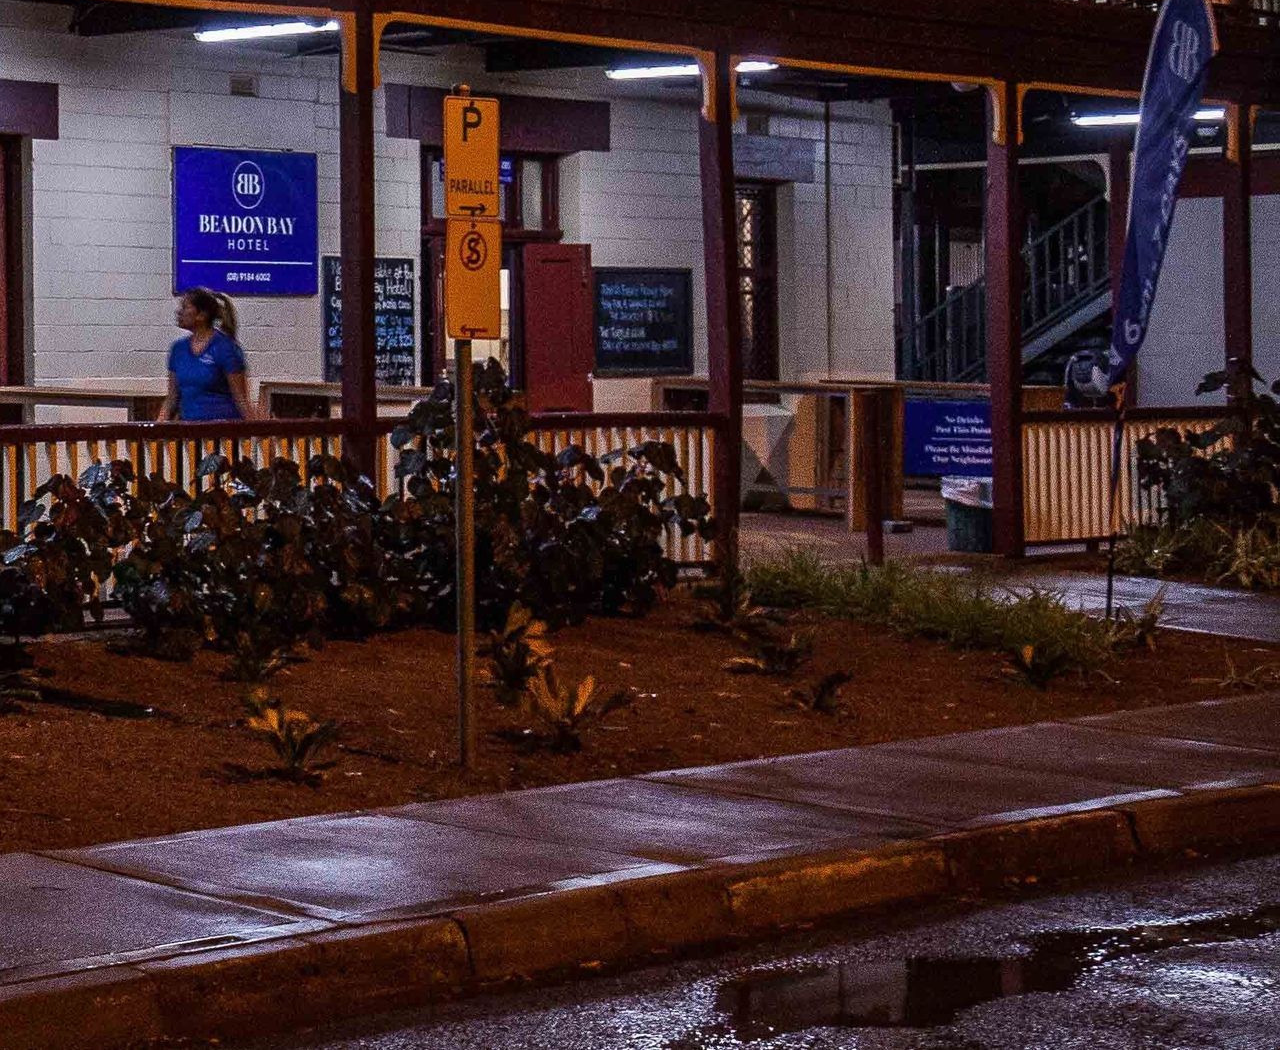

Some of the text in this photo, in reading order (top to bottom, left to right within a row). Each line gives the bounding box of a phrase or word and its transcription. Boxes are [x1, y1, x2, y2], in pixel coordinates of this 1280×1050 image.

[462, 105, 482, 142] P
[449, 178, 496, 196] PARALLEL
[199, 214, 297, 236] BEADON BAY
[227, 238, 270, 251] HOTEL
